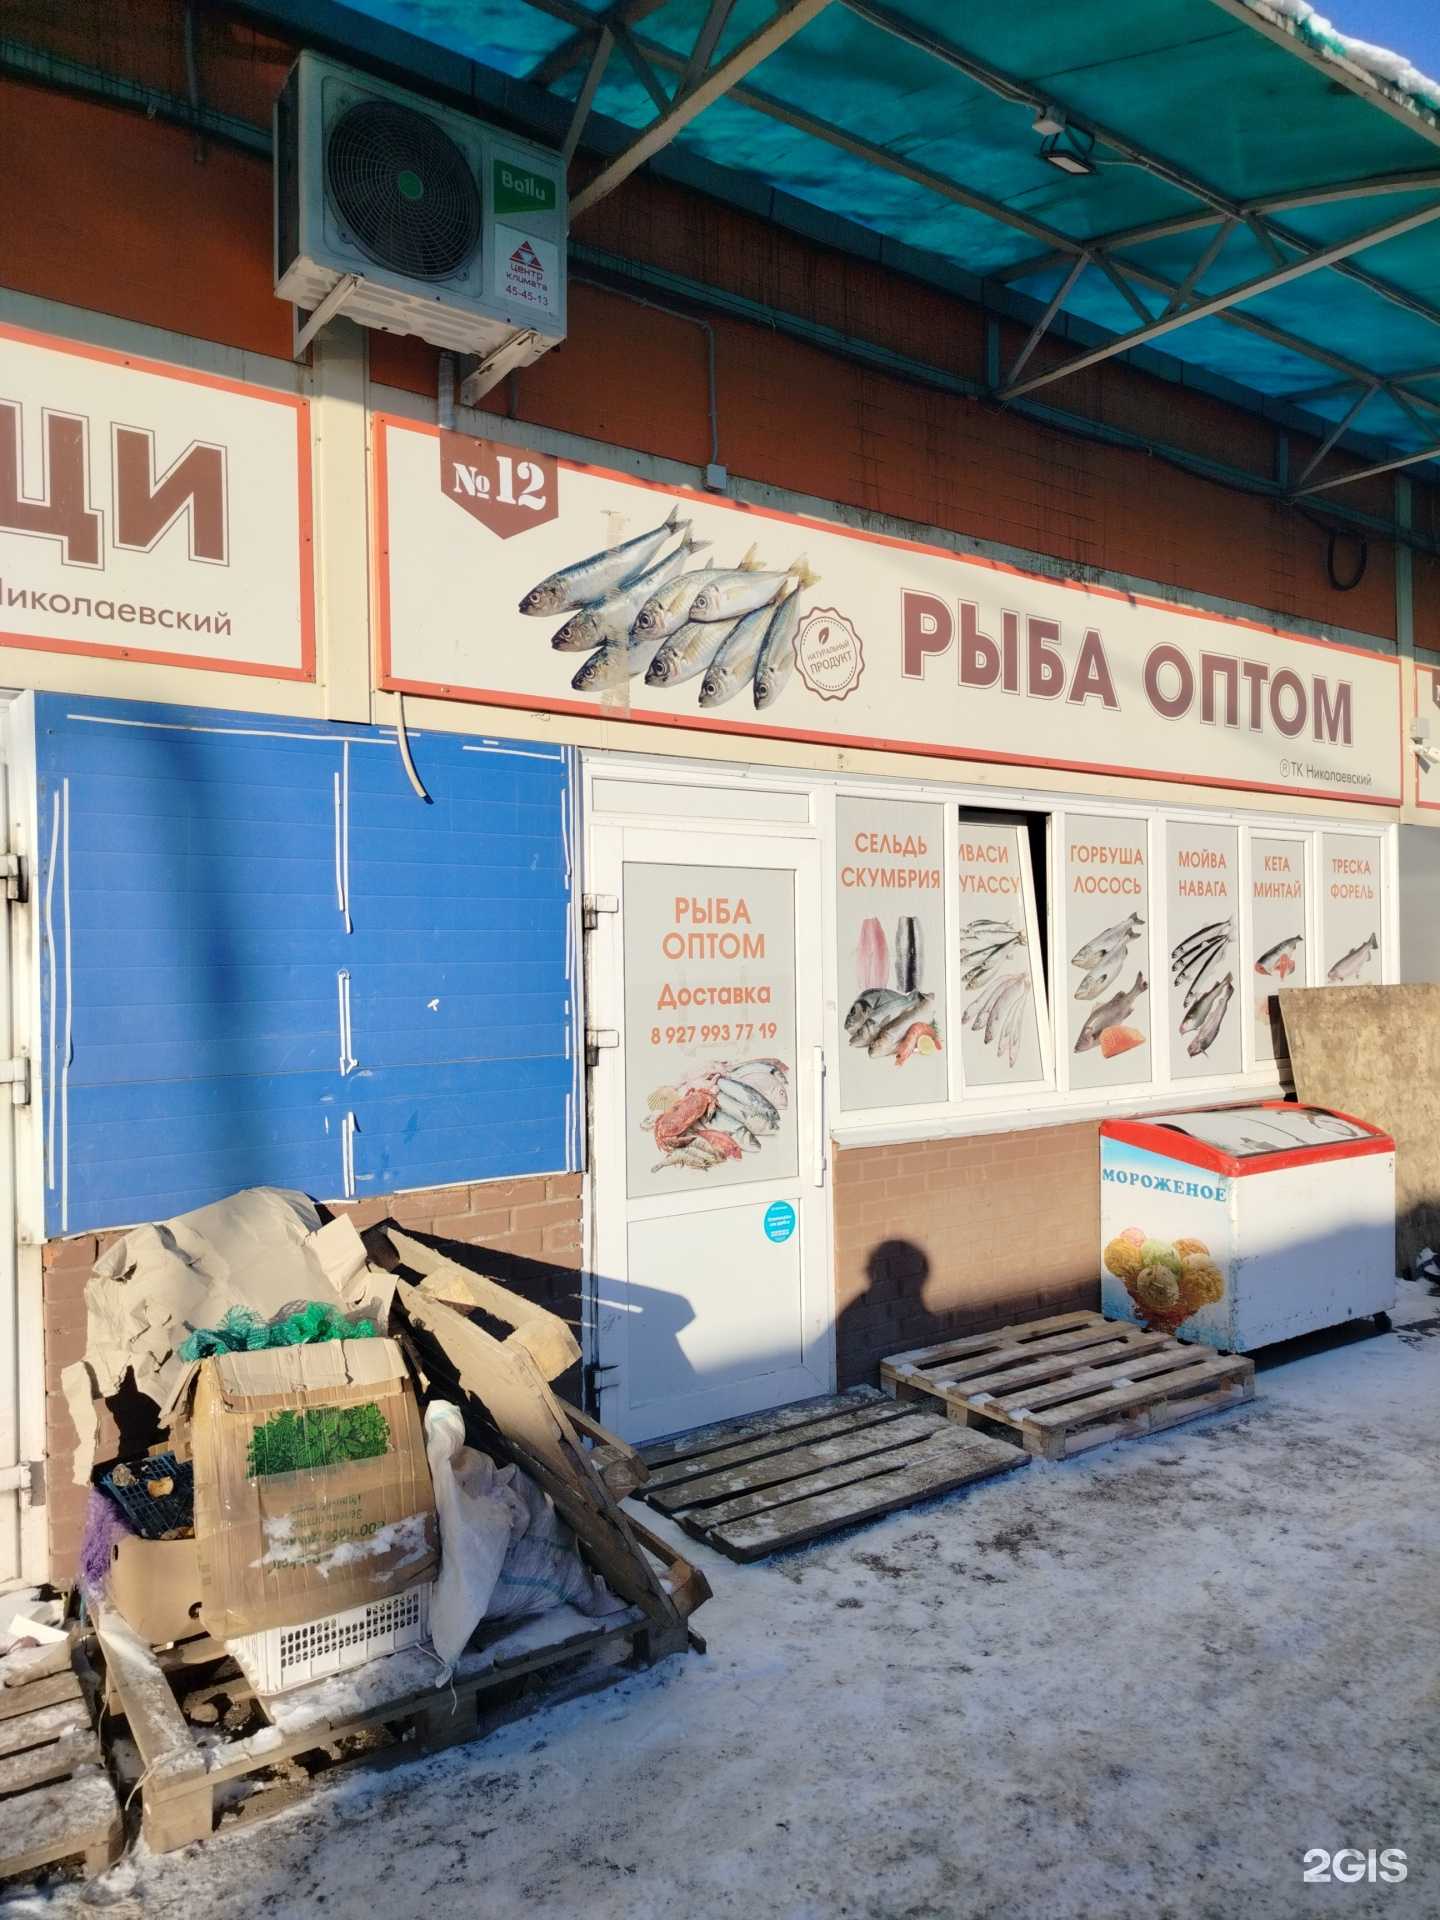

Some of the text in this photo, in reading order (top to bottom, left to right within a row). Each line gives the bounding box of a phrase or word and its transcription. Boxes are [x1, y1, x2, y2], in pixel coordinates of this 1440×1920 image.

[502, 170, 546, 200] Ballu
[0, 577, 231, 636] иколаевский
[807, 639, 850, 660] НАТУРАЛЬНЫЙ
[810, 651, 853, 673] ПРОДУКТ
[900, 587, 1354, 747] РЫБА ОПТОМ
[1306, 763, 1372, 786] Николаевский
[855, 832, 927, 858] СЕЛЬДЬ
[1070, 844, 1144, 866] ГОРБУША
[1178, 849, 1227, 869] МОЙВА
[1264, 855, 1291, 872] КЕТА
[1332, 858, 1371, 875] ТРЕСКА
[841, 867, 940, 889] СКУМБРИЯ
[1073, 876, 1143, 895] ЛОСОСЬ
[1178, 879, 1228, 898] НАВАГА
[1253, 879, 1302, 899] МИНТАЙ
[1330, 883, 1374, 900] ФОРЕЛЬ
[675, 897, 751, 924] РЫБА
[662, 932, 766, 960] ОПТОМ
[657, 983, 772, 1011] Доставка
[651, 1022, 777, 1045] 8 927 993 77 19
[1102, 1167, 1227, 1202] МОРОЖЕНОЕ
